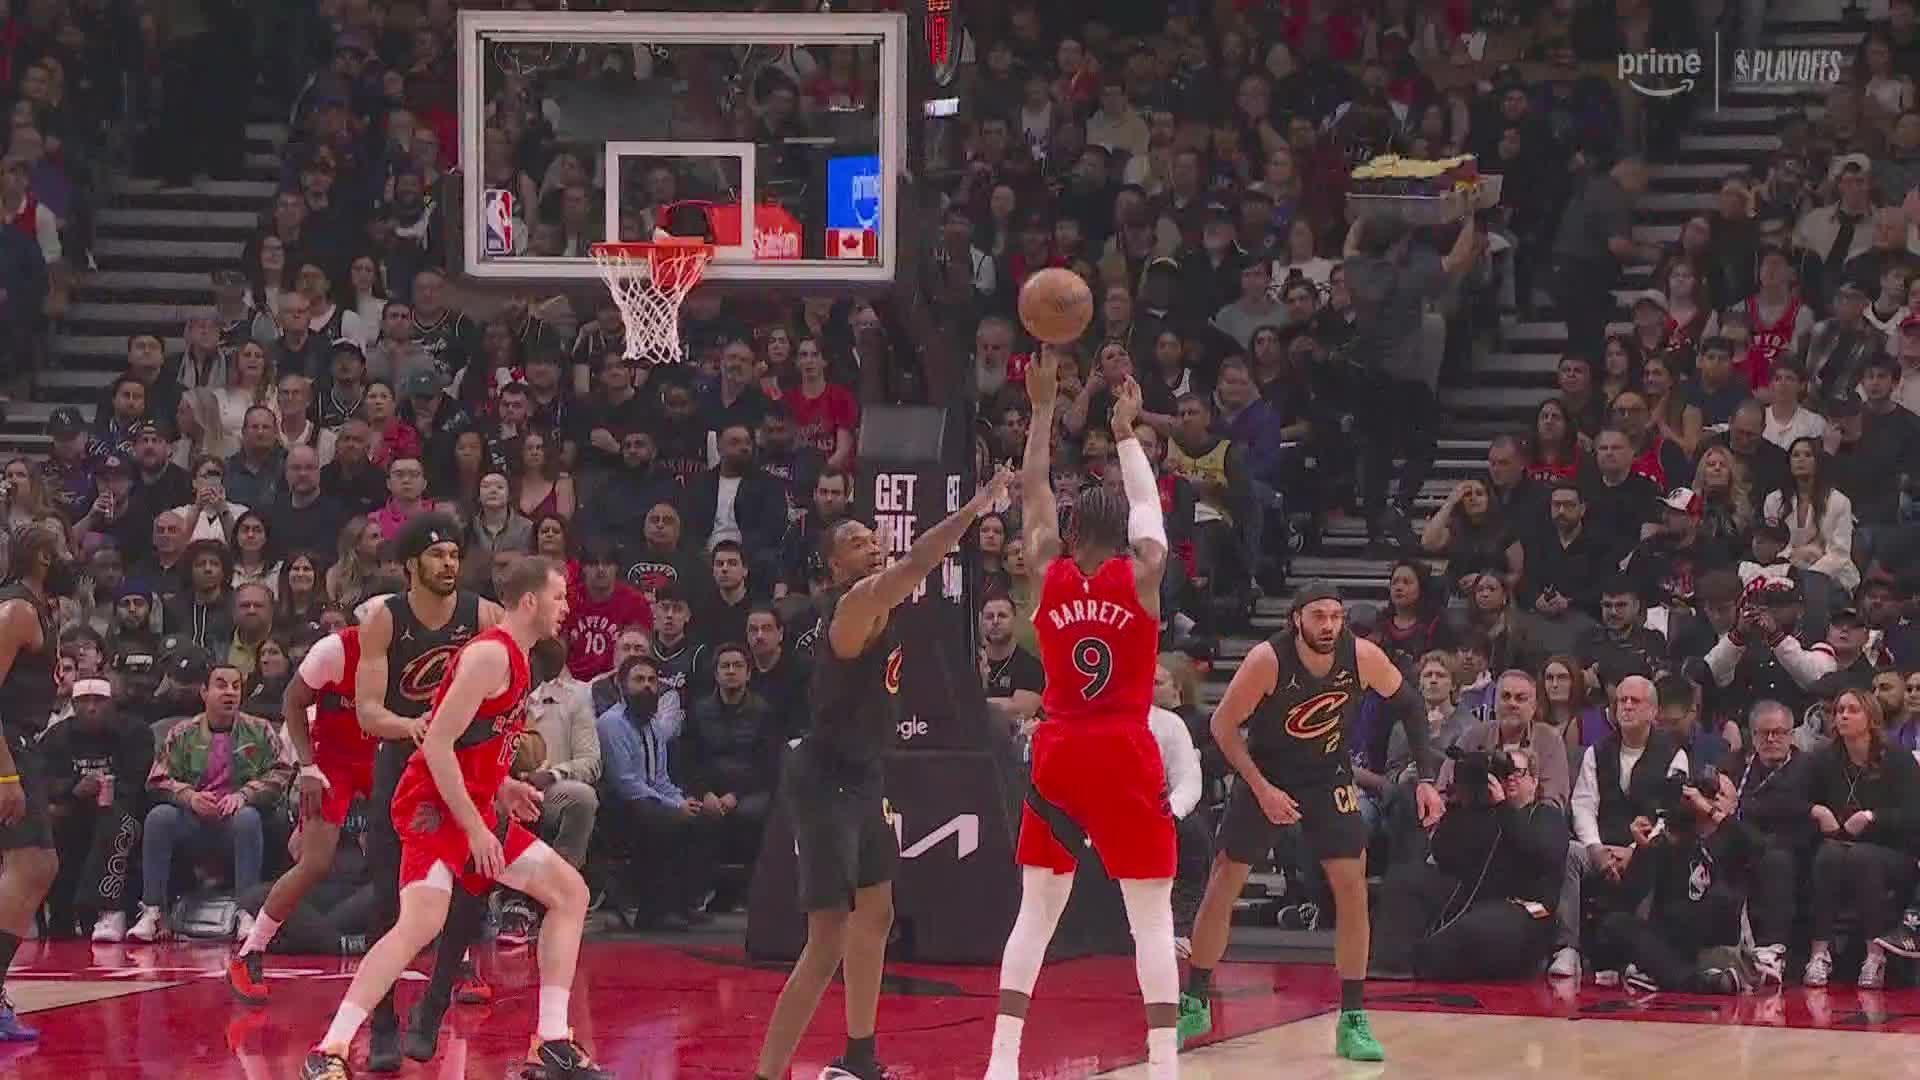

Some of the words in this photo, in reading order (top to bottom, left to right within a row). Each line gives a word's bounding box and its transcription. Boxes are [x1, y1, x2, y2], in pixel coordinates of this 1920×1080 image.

[875, 474, 917, 511] GET
[875, 515, 917, 552] THE
[1048, 599, 1136, 630] BARRETT
[585, 632, 606, 655] 10
[1072, 636, 1113, 701] 9
